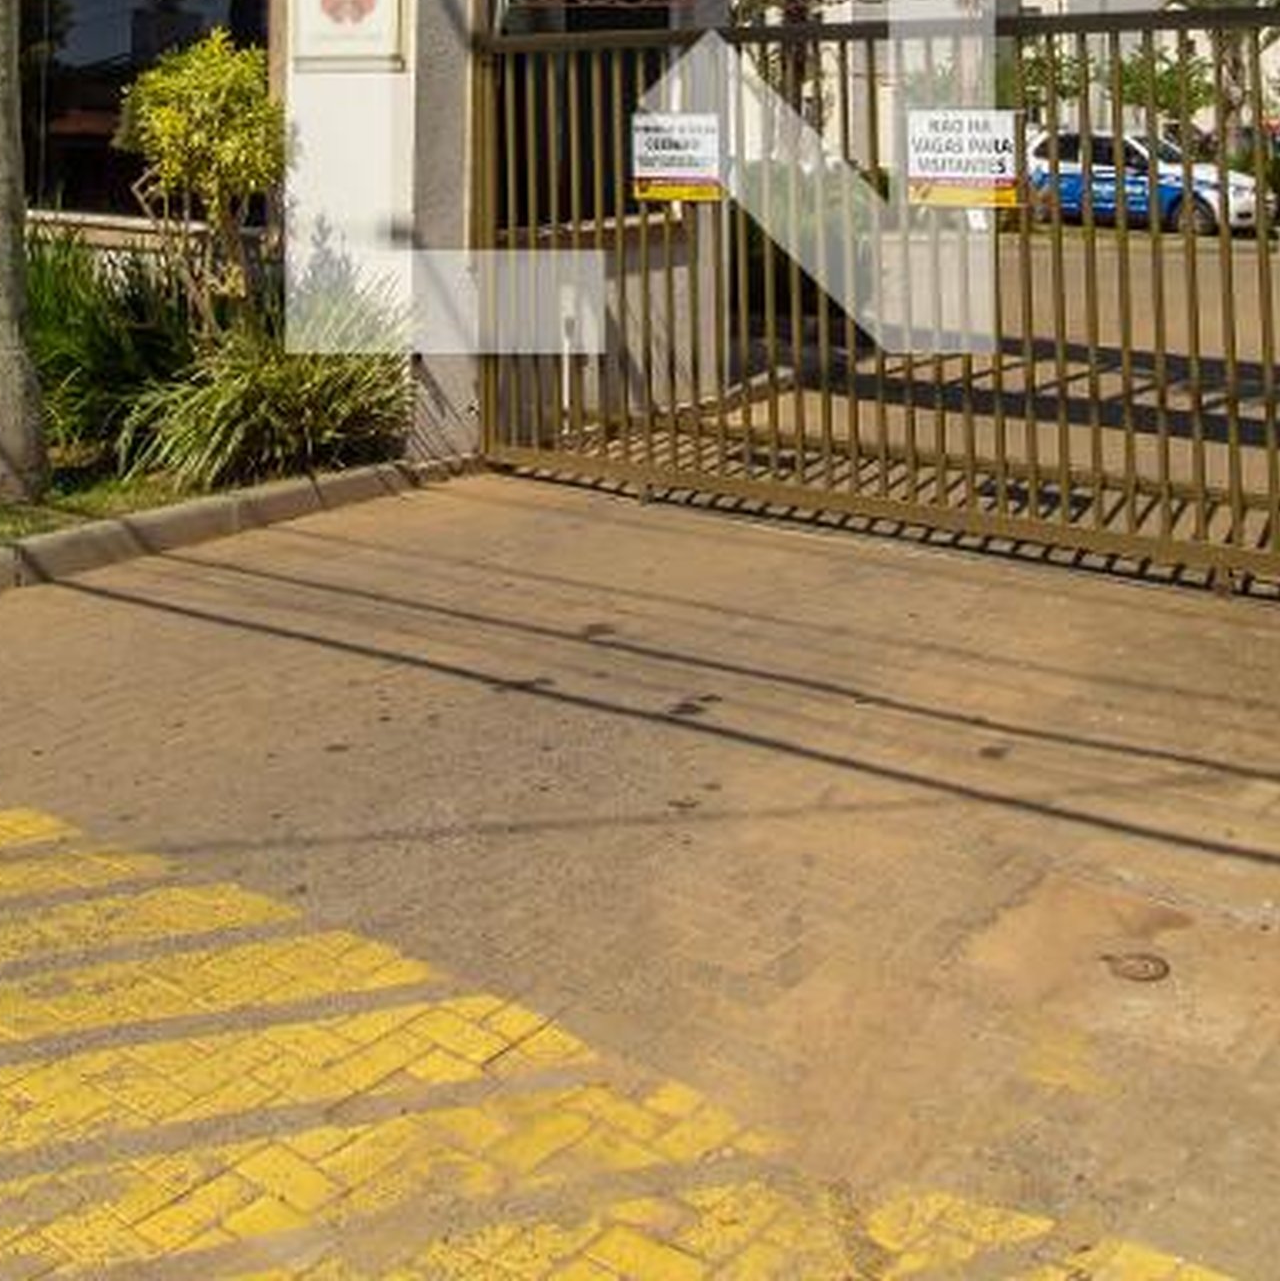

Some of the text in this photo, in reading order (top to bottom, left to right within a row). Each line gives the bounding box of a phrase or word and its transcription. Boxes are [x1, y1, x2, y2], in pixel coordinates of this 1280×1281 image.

[910, 137, 1014, 154] VAGAS PARA
[917, 157, 1007, 174] VISITANTES
